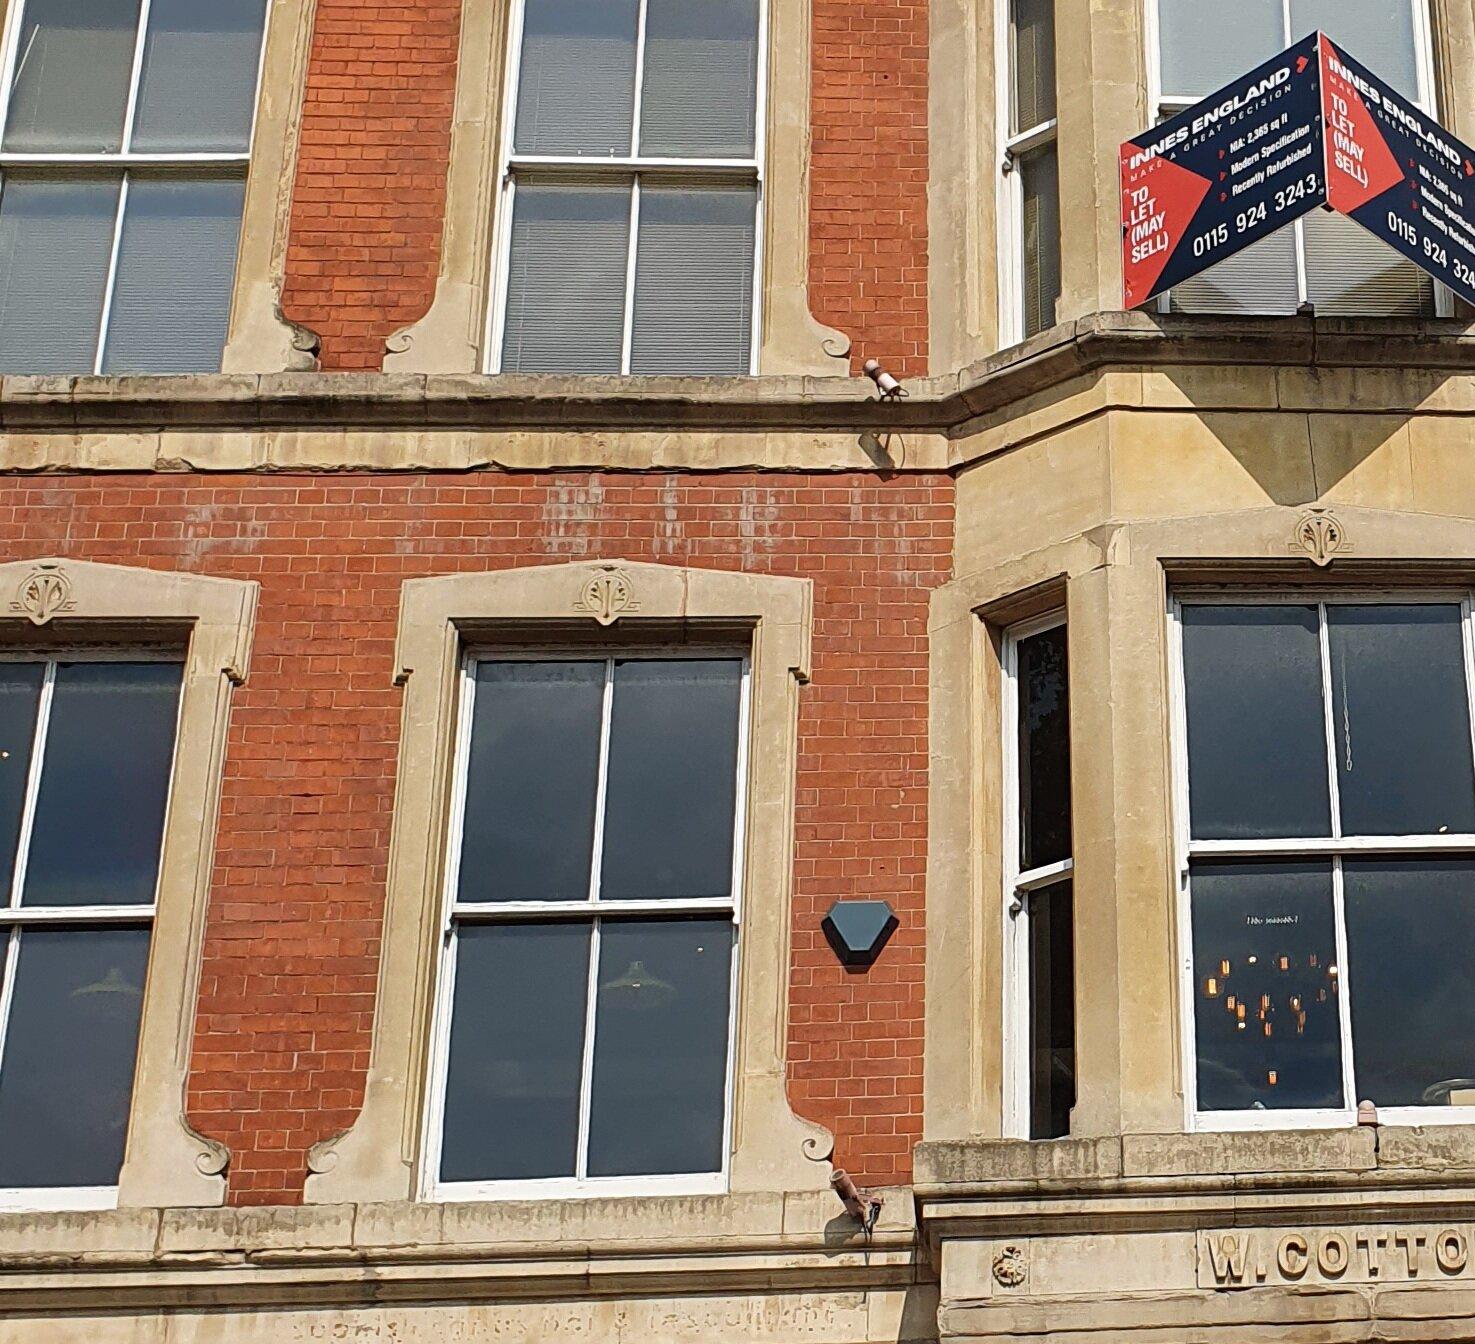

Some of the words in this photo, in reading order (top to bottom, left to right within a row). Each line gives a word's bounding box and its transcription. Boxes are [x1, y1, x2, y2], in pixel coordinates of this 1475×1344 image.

[1130, 126, 1189, 169] INNES
[1192, 67, 1290, 136] ENGLAND
[1329, 56, 1380, 104] INNES
[1384, 97, 1461, 166] ENGLAND
[1331, 92, 1347, 116] TO
[1130, 159, 1163, 182] MAKE
[1169, 152, 1177, 160] A
[1184, 123, 1223, 152] GREAT
[1230, 84, 1292, 125] DECISION
[1270, 119, 1280, 134] sq
[1332, 113, 1355, 138] LET
[1334, 132, 1364, 158] (MAY
[1377, 110, 1411, 139] GREAT
[1415, 139, 1463, 180] DECISION
[1231, 152, 1259, 176] Modern
[1261, 124, 1310, 159] Specification
[1232, 169, 1265, 197] Recently
[1266, 142, 1312, 178] Refurbished
[1335, 150, 1368, 189] SELL)
[1131, 185, 1148, 206] TO
[1131, 198, 1157, 225] LET
[1193, 223, 1228, 257] 0115
[1236, 202, 1267, 233] 924
[1275, 173, 1317, 212] 3243
[1131, 211, 1166, 245] (MAY
[1131, 231, 1169, 264] SELL)
[1388, 211, 1417, 246] 0115
[1424, 237, 1447, 268] 924
